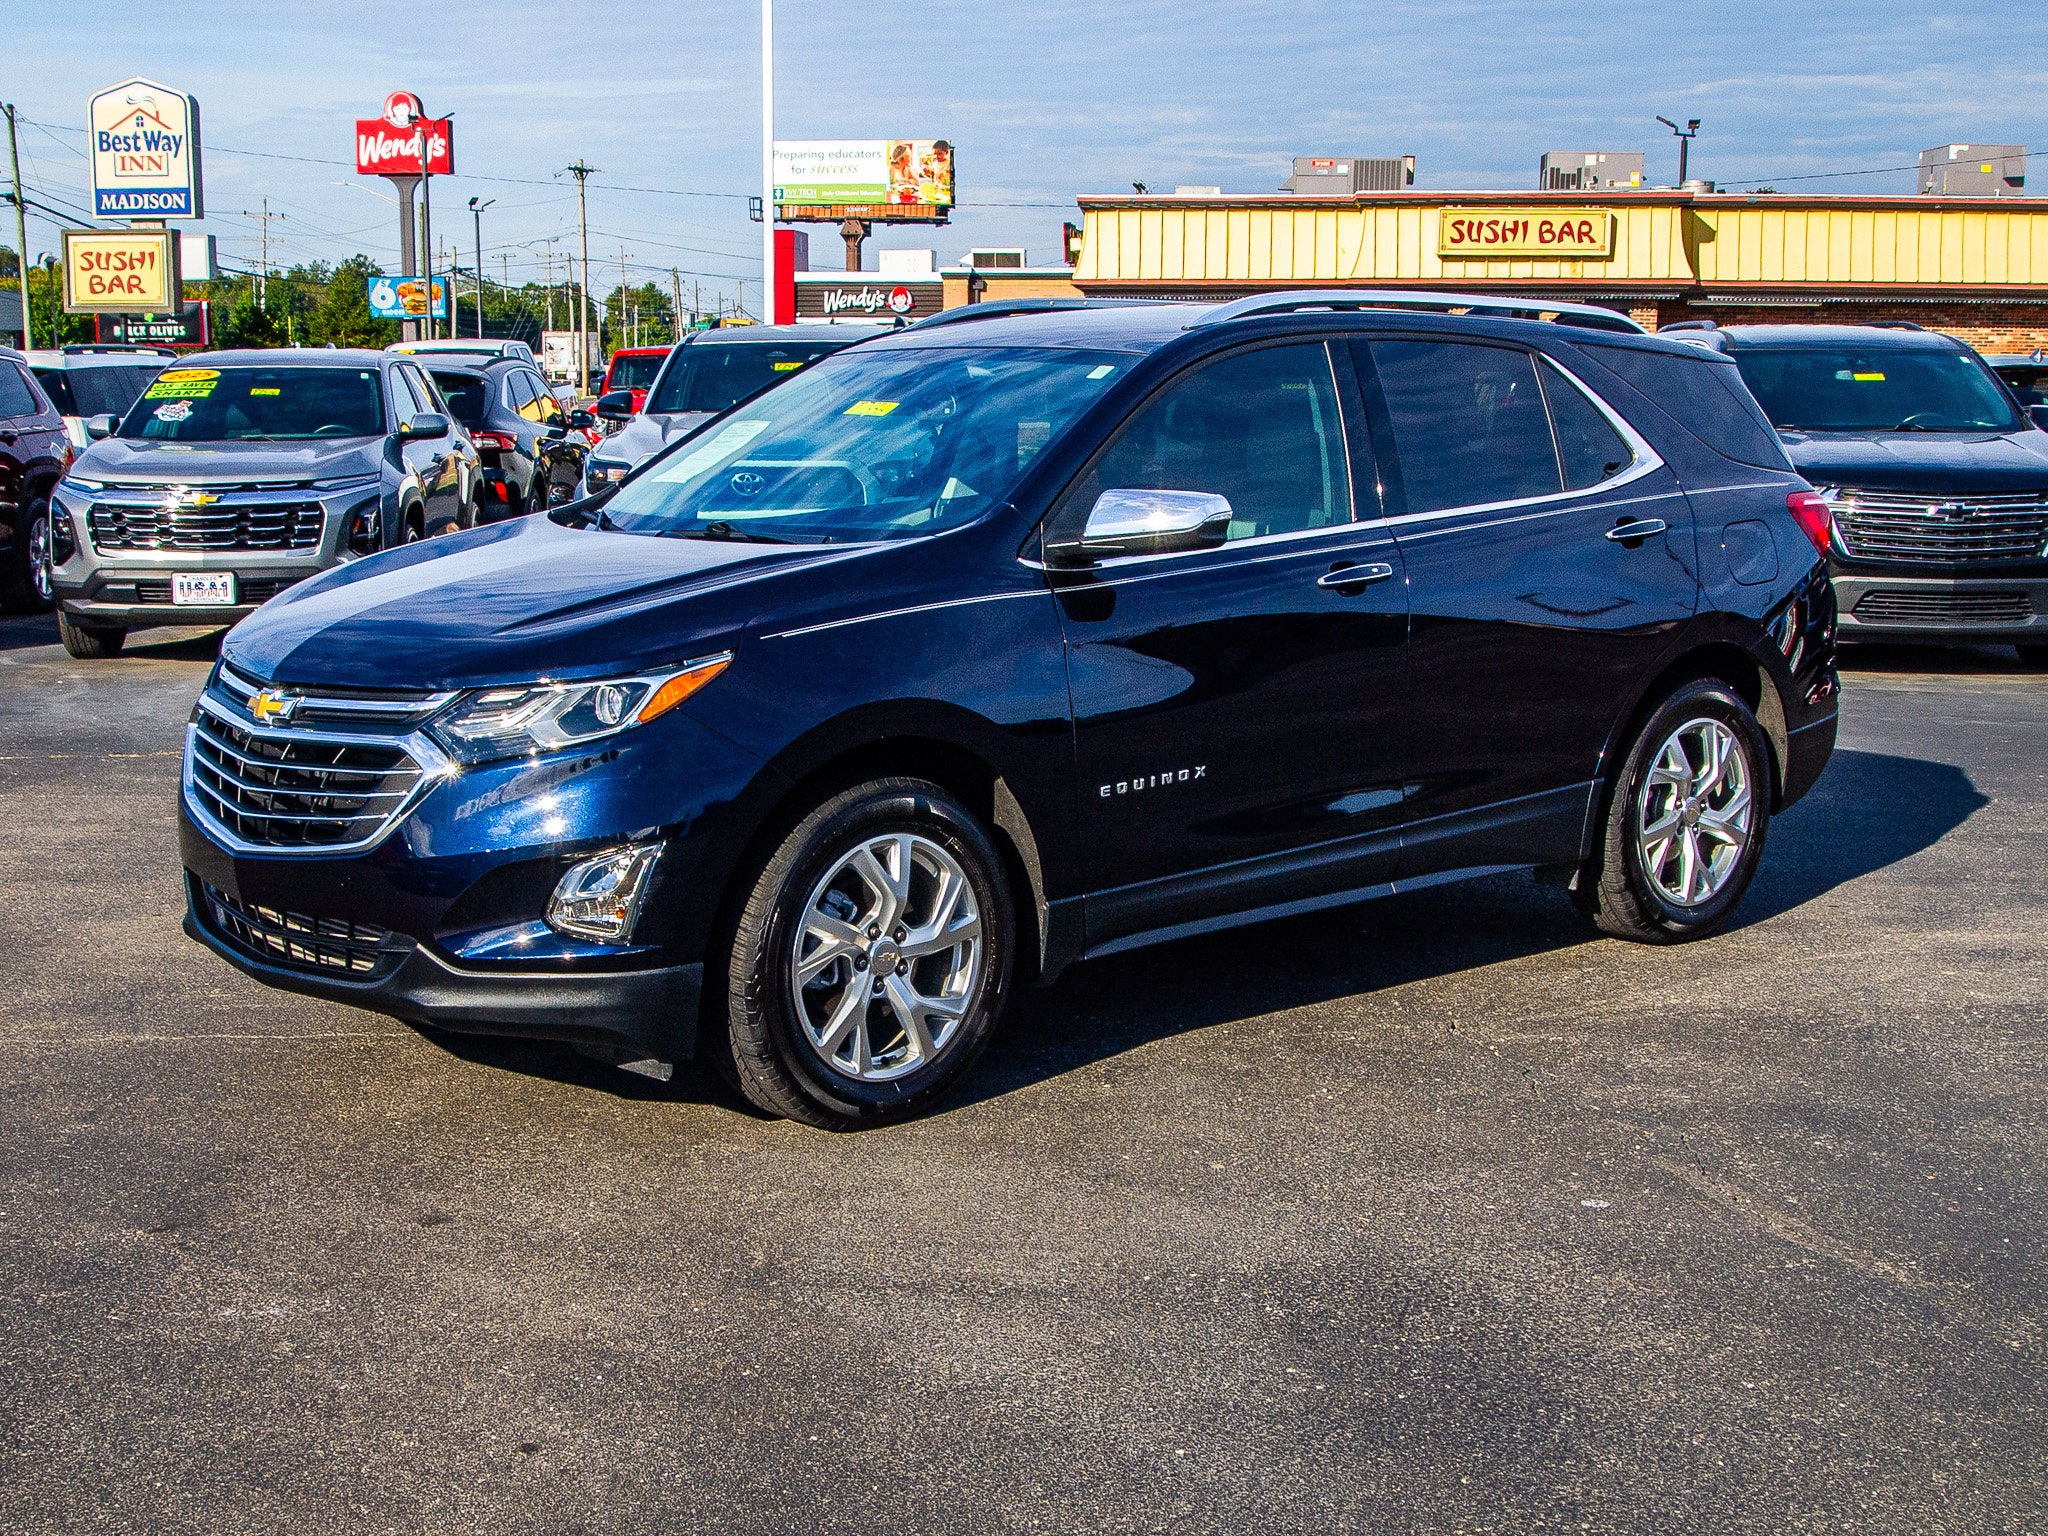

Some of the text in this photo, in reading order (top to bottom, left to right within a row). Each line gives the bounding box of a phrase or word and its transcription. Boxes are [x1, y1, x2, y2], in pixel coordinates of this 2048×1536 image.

[98, 130, 183, 158] Best Way
[358, 127, 446, 166] Wendy's
[119, 155, 163, 171] INN
[773, 149, 882, 161] Preparing educators
[791, 164, 859, 174] for success
[101, 193, 186, 210] MADISON
[1450, 220, 1596, 244] SUSHI BAR
[80, 251, 155, 271] SUSHI
[89, 274, 146, 294] BAR
[823, 286, 886, 313] Wendy's
[149, 325, 187, 338] OLIVES
[166, 372, 214, 380] 2025
[152, 390, 205, 398] SHARP
[1100, 765, 1206, 797] EQUINOX
